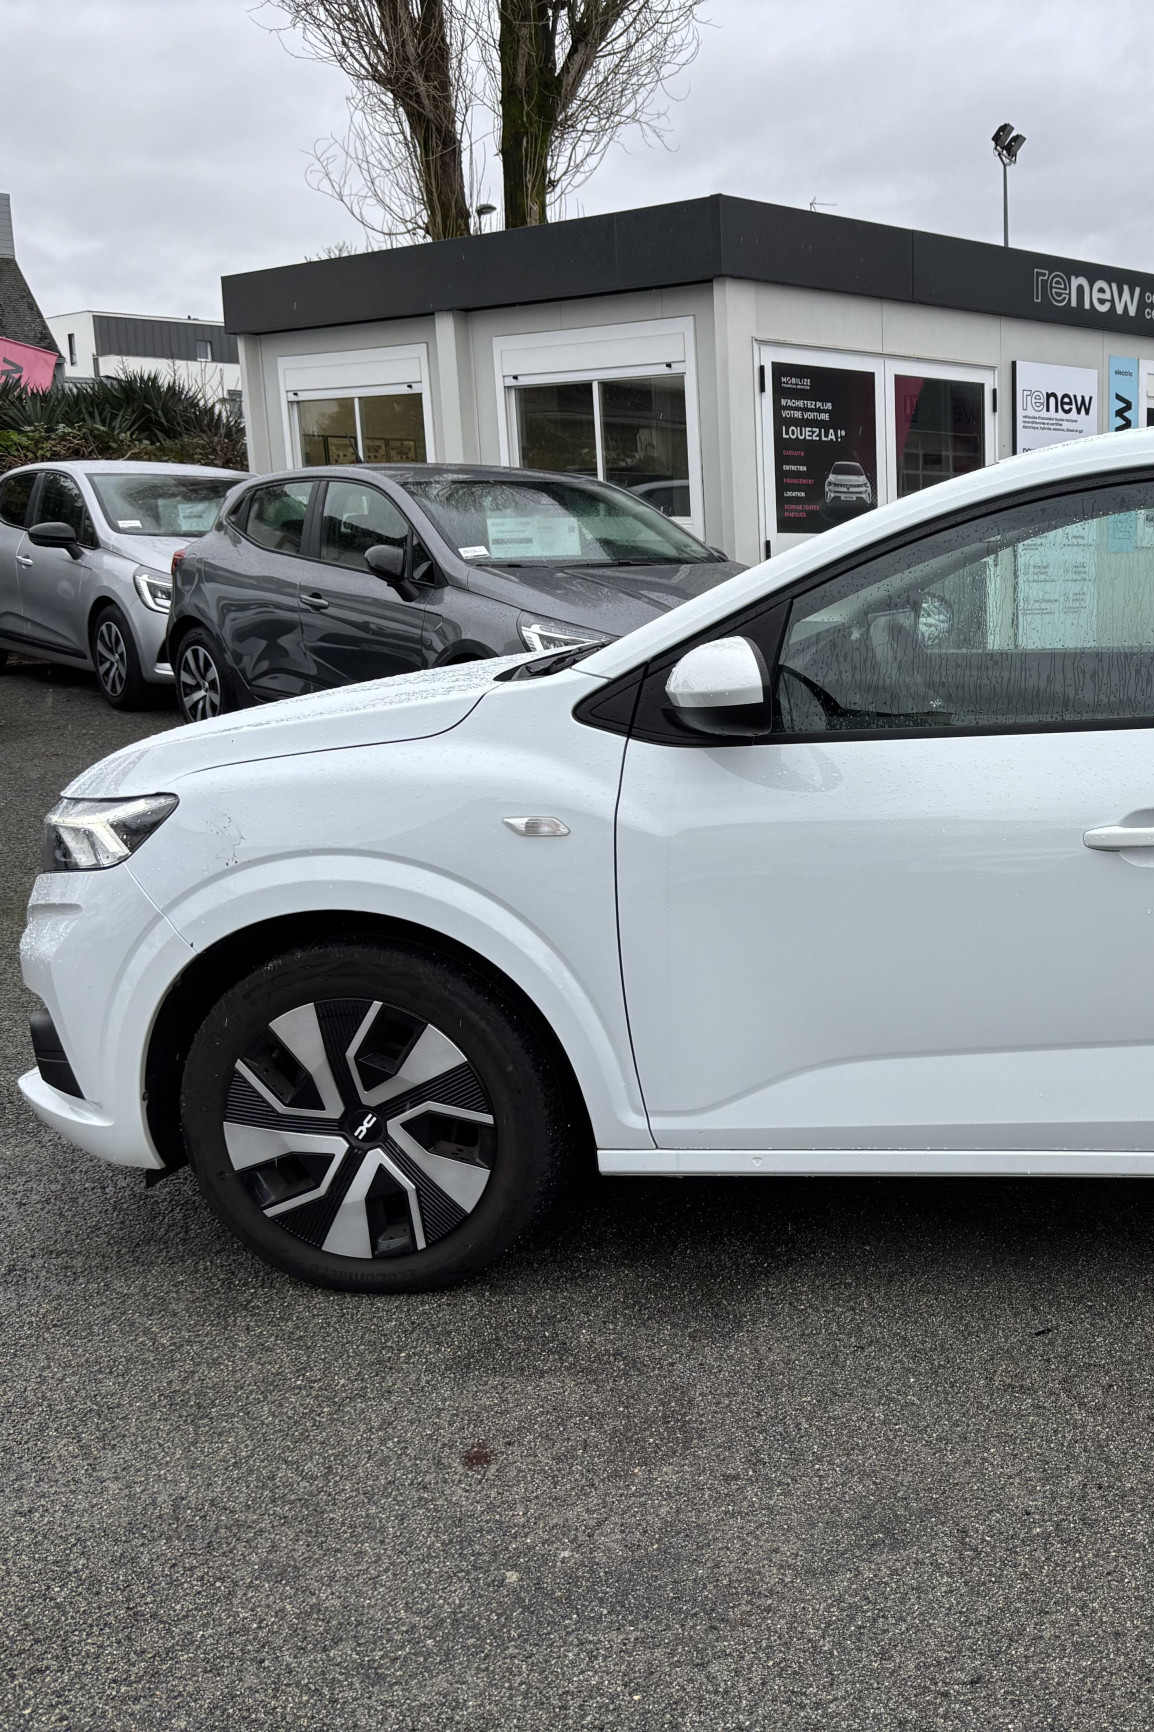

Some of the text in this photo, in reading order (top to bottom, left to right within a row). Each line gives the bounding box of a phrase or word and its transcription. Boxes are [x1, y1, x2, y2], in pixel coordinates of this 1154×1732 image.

[1034, 268, 1141, 317] renew
[1114, 369, 1133, 377] electric
[781, 376, 811, 385] MOBILIZE
[781, 398, 832, 410] N'ACHETEZ PLUS
[1022, 389, 1093, 416] renew
[781, 410, 830, 421] VOTRE VOITURE
[782, 425, 819, 440] LOUEZ
[821, 428, 836, 442] LA
